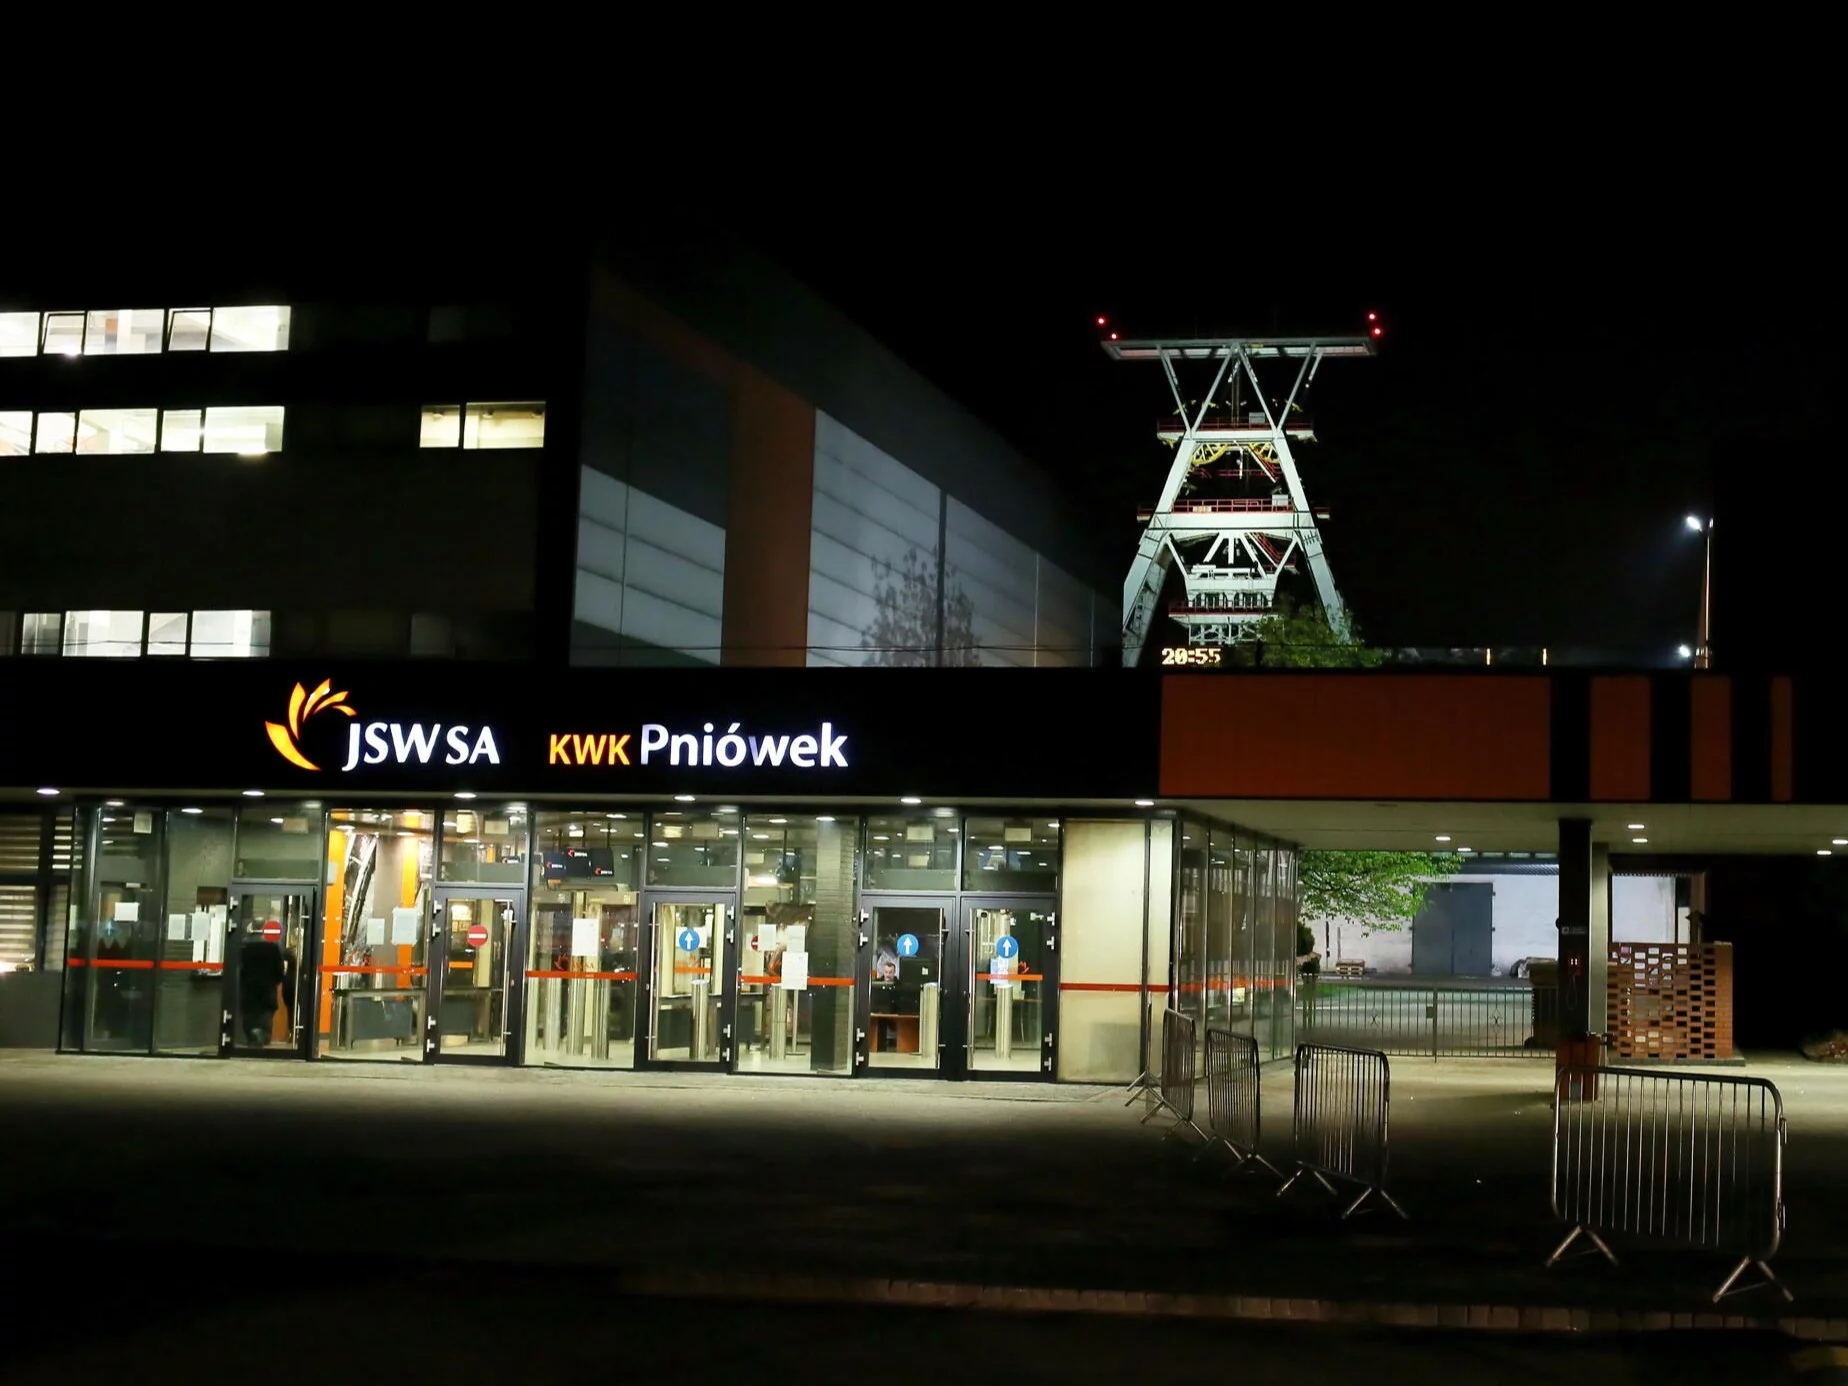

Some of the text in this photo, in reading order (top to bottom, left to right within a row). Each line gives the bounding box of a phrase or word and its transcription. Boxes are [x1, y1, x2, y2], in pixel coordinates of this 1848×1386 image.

[1161, 647, 1221, 665] 20:55
[340, 721, 501, 772] JSW SA
[549, 721, 849, 768] KWK Pniówek
